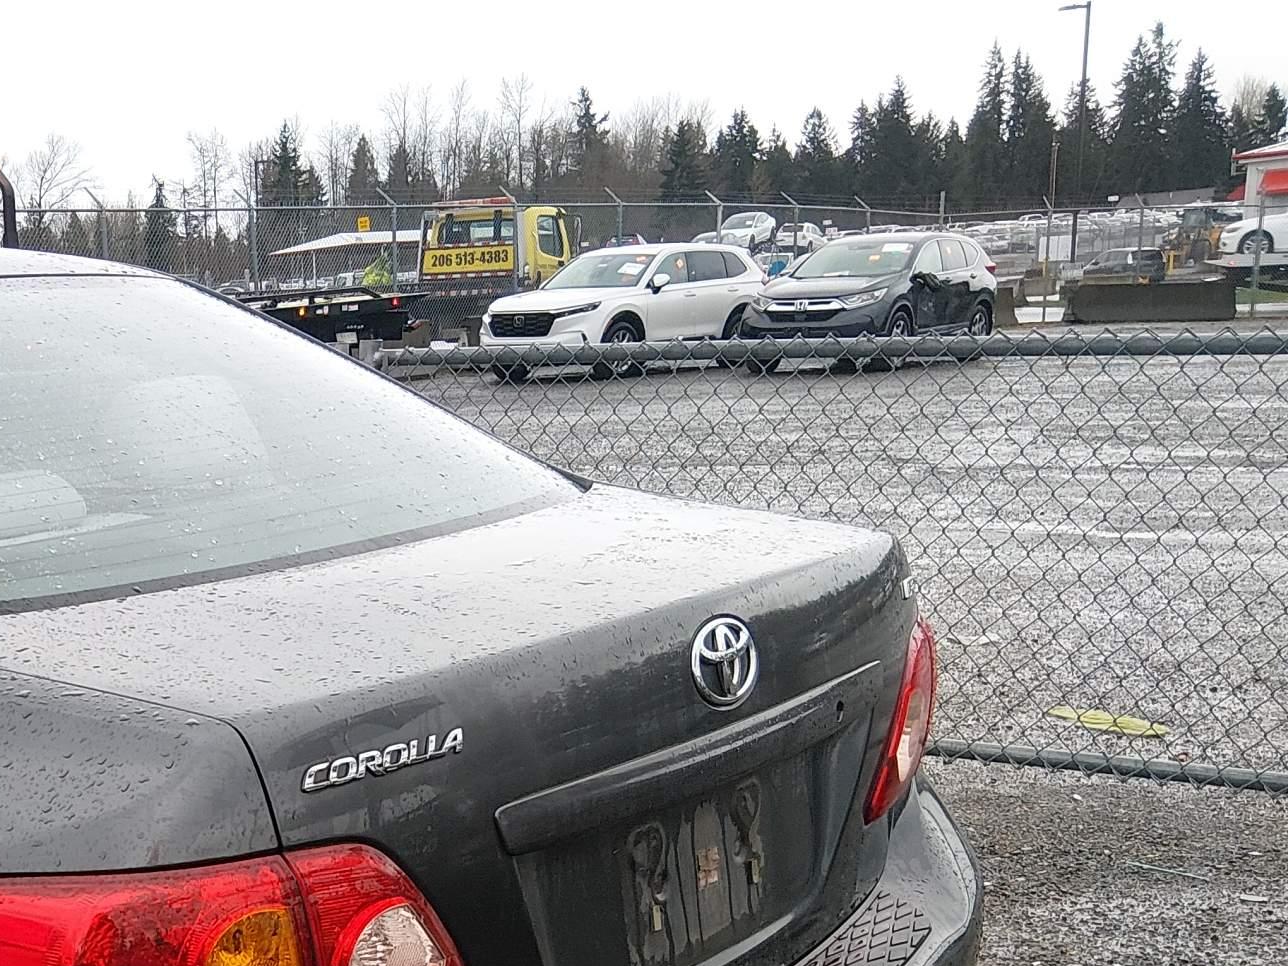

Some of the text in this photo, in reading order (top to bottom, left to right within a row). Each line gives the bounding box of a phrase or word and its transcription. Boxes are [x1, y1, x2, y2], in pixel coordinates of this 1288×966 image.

[431, 248, 509, 268] 206 513-4383
[301, 727, 464, 793] COROLLA
